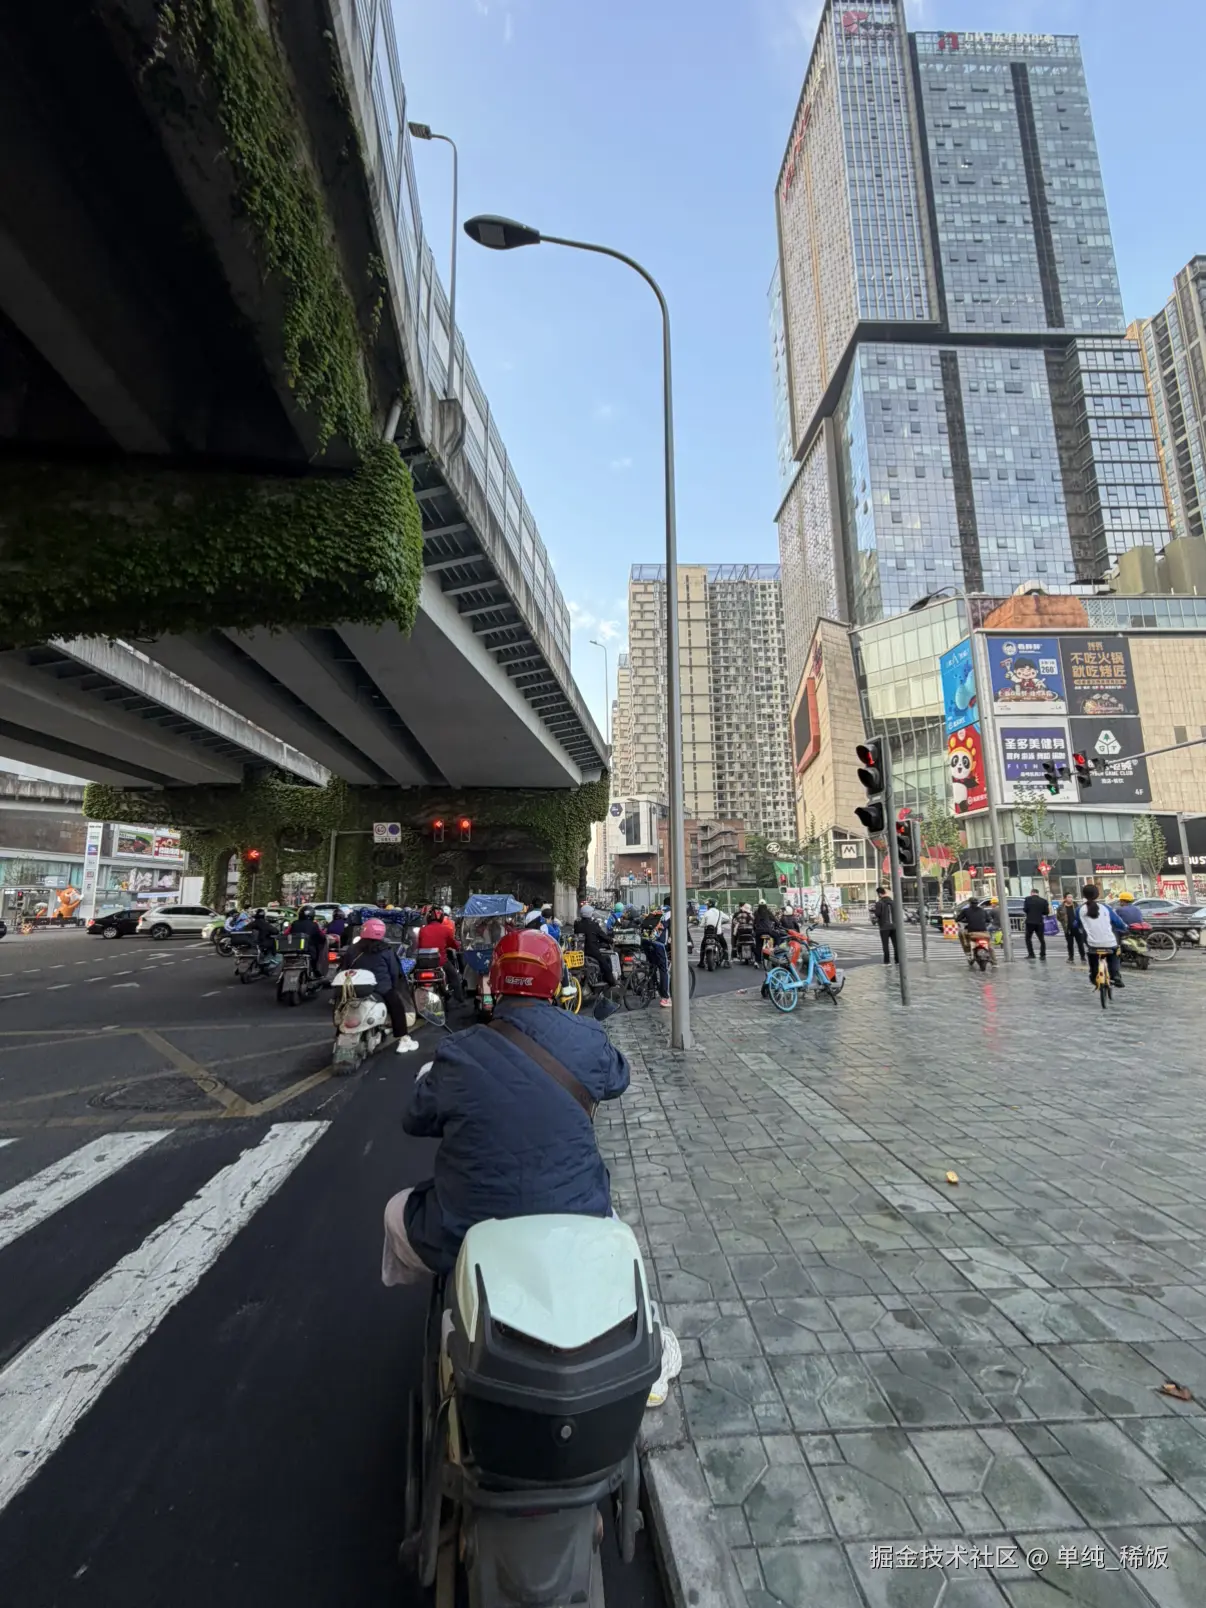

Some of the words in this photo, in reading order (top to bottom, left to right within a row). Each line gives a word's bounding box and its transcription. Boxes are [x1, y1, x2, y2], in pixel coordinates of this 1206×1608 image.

[1070, 651, 1124, 665] 不吃火锅
[1072, 665, 1127, 678] 就吃烤匠
[1004, 738, 1065, 750] 圣多美健身
